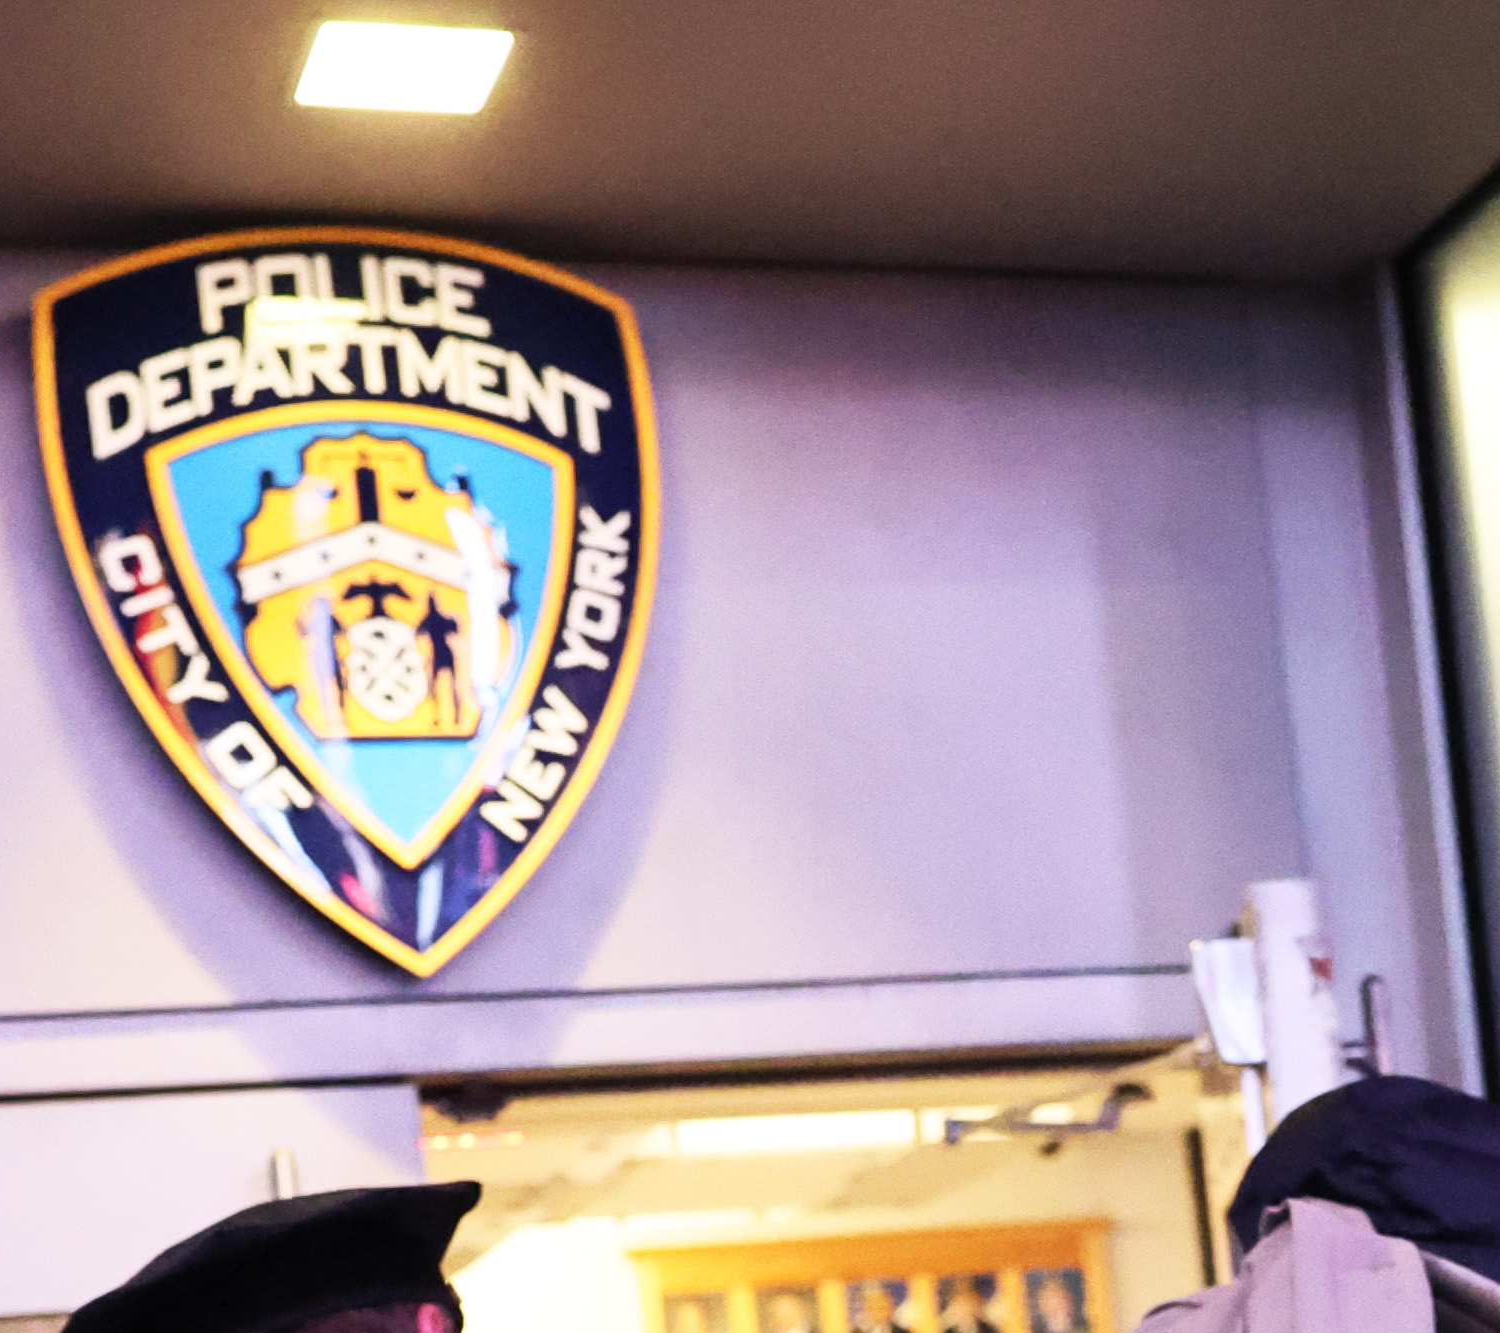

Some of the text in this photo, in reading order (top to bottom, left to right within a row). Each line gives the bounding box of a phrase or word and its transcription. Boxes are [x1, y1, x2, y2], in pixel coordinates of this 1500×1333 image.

[85, 322, 612, 460] DEPARTMENT
[196, 252, 492, 338] POLICE
[99, 534, 315, 813] CITY OF
[479, 504, 633, 843] NEW YORK
